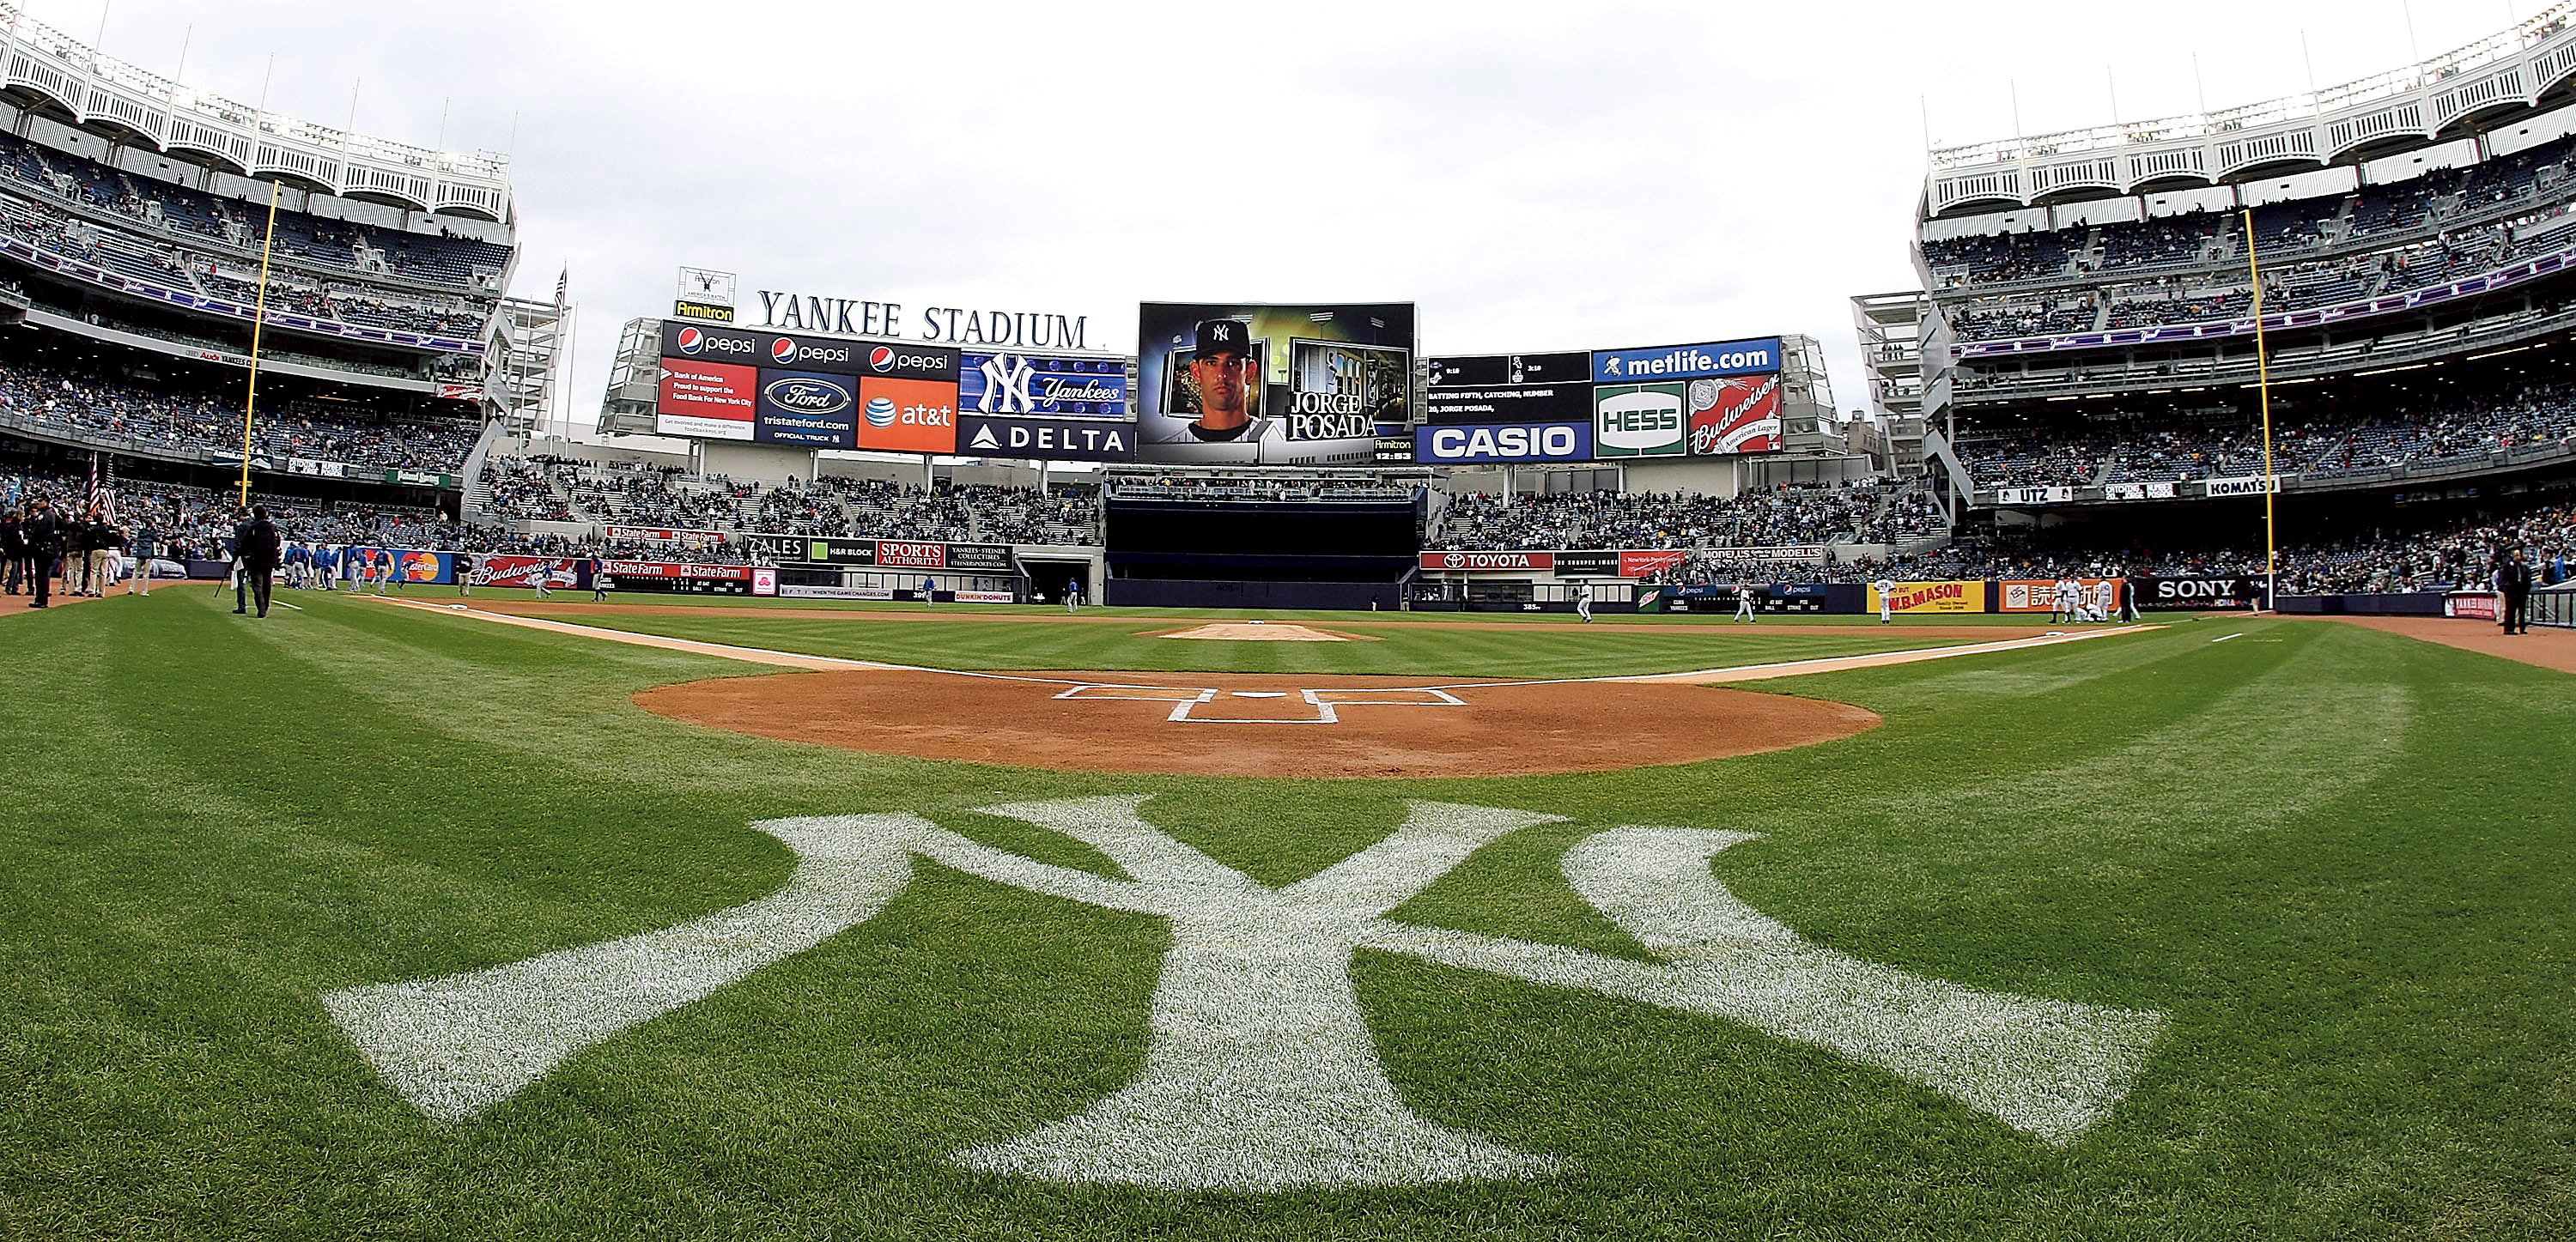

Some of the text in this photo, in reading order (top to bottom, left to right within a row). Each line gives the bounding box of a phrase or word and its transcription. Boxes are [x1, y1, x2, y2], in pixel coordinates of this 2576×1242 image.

[677, 302, 732, 321] Armitron
[757, 290, 1087, 349] YANKEE STADIUM
[705, 336, 756, 354] pepsi
[200, 352, 220, 360] Audi
[799, 347, 848, 363] pepsi
[897, 354, 948, 371] pepsi
[1628, 349, 1767, 375] metlife.com
[698, 374, 724, 383] America
[785, 385, 830, 408] Ford
[1042, 377, 1120, 408] Yankees
[741, 398, 752, 407] City
[1291, 391, 1361, 414] JORGE
[902, 403, 951, 427] at&t
[1603, 408, 1678, 433] HESS
[1689, 374, 1780, 454] Budweiser
[764, 416, 848, 430] tristateford.com
[1290, 414, 1378, 439] POSADA
[1011, 427, 1124, 451] DELTA
[1375, 439, 1411, 449] Armitron
[1432, 427, 1576, 457] CASIO
[1725, 427, 1756, 447] American
[2020, 488, 2048, 502] UTZ
[749, 538, 800, 554] ZALES
[881, 542, 941, 558] SPORTS
[1771, 548, 1820, 558] MODELL'S
[881, 556, 941, 566] AUTHORITY
[1467, 554, 1529, 567] TOYOTA
[1686, 586, 1704, 595] pepsi
[1793, 585, 1811, 594] pepsi
[2159, 580, 2235, 597] SONY
